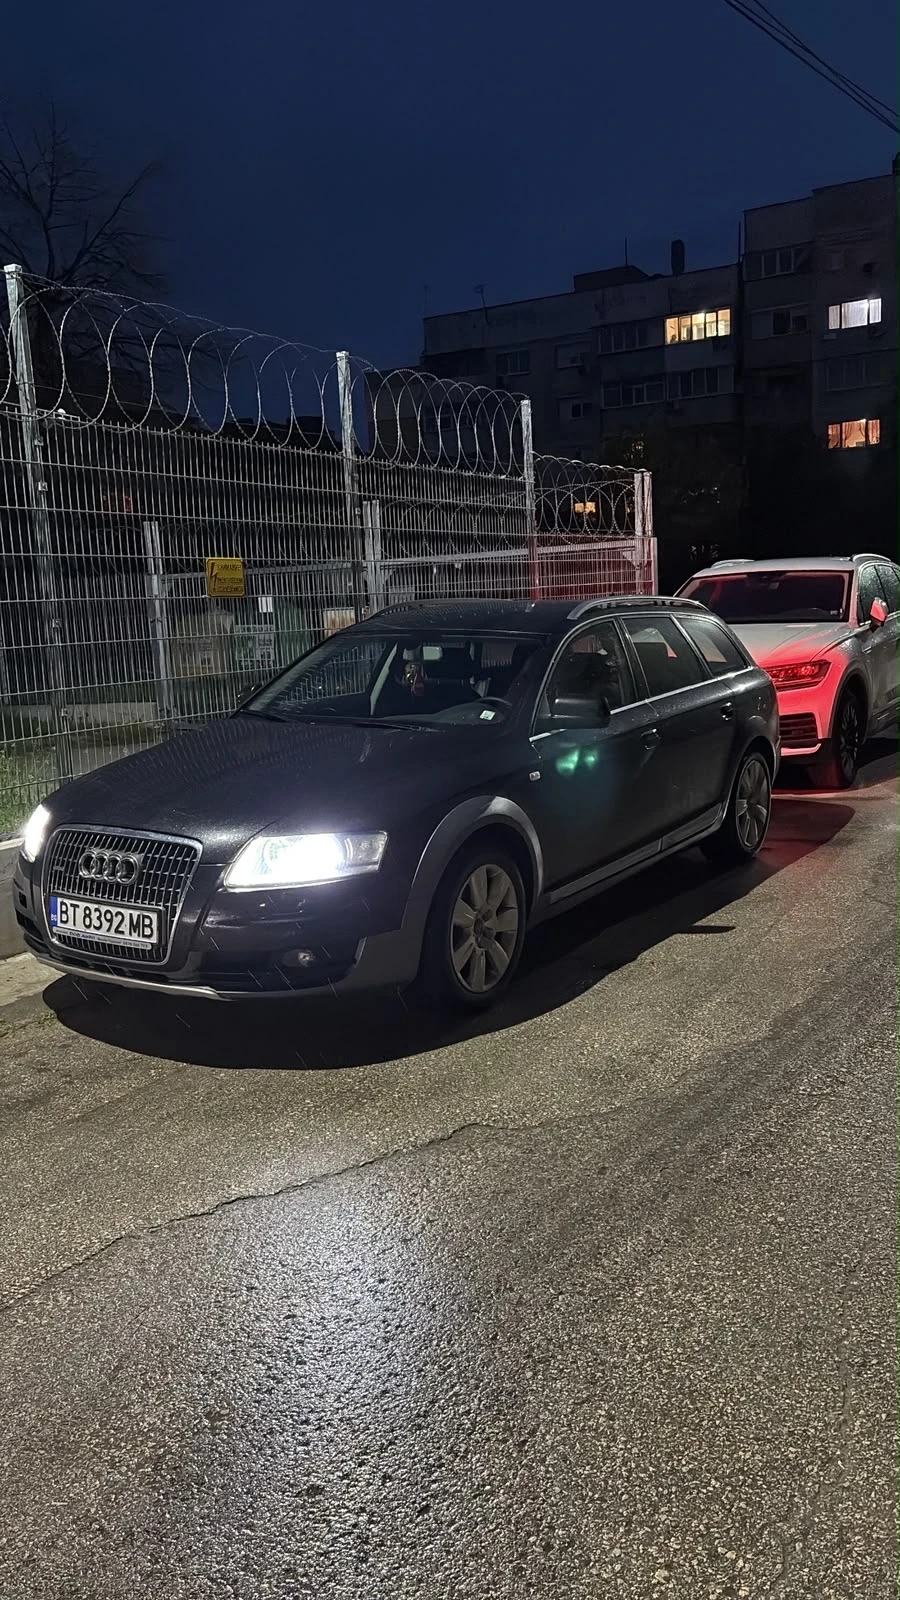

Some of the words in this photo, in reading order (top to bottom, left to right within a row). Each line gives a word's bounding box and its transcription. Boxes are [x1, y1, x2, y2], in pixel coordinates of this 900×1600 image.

[60, 901, 79, 927] BT
[83, 906, 125, 935] 8392
[129, 913, 153, 938] MB
